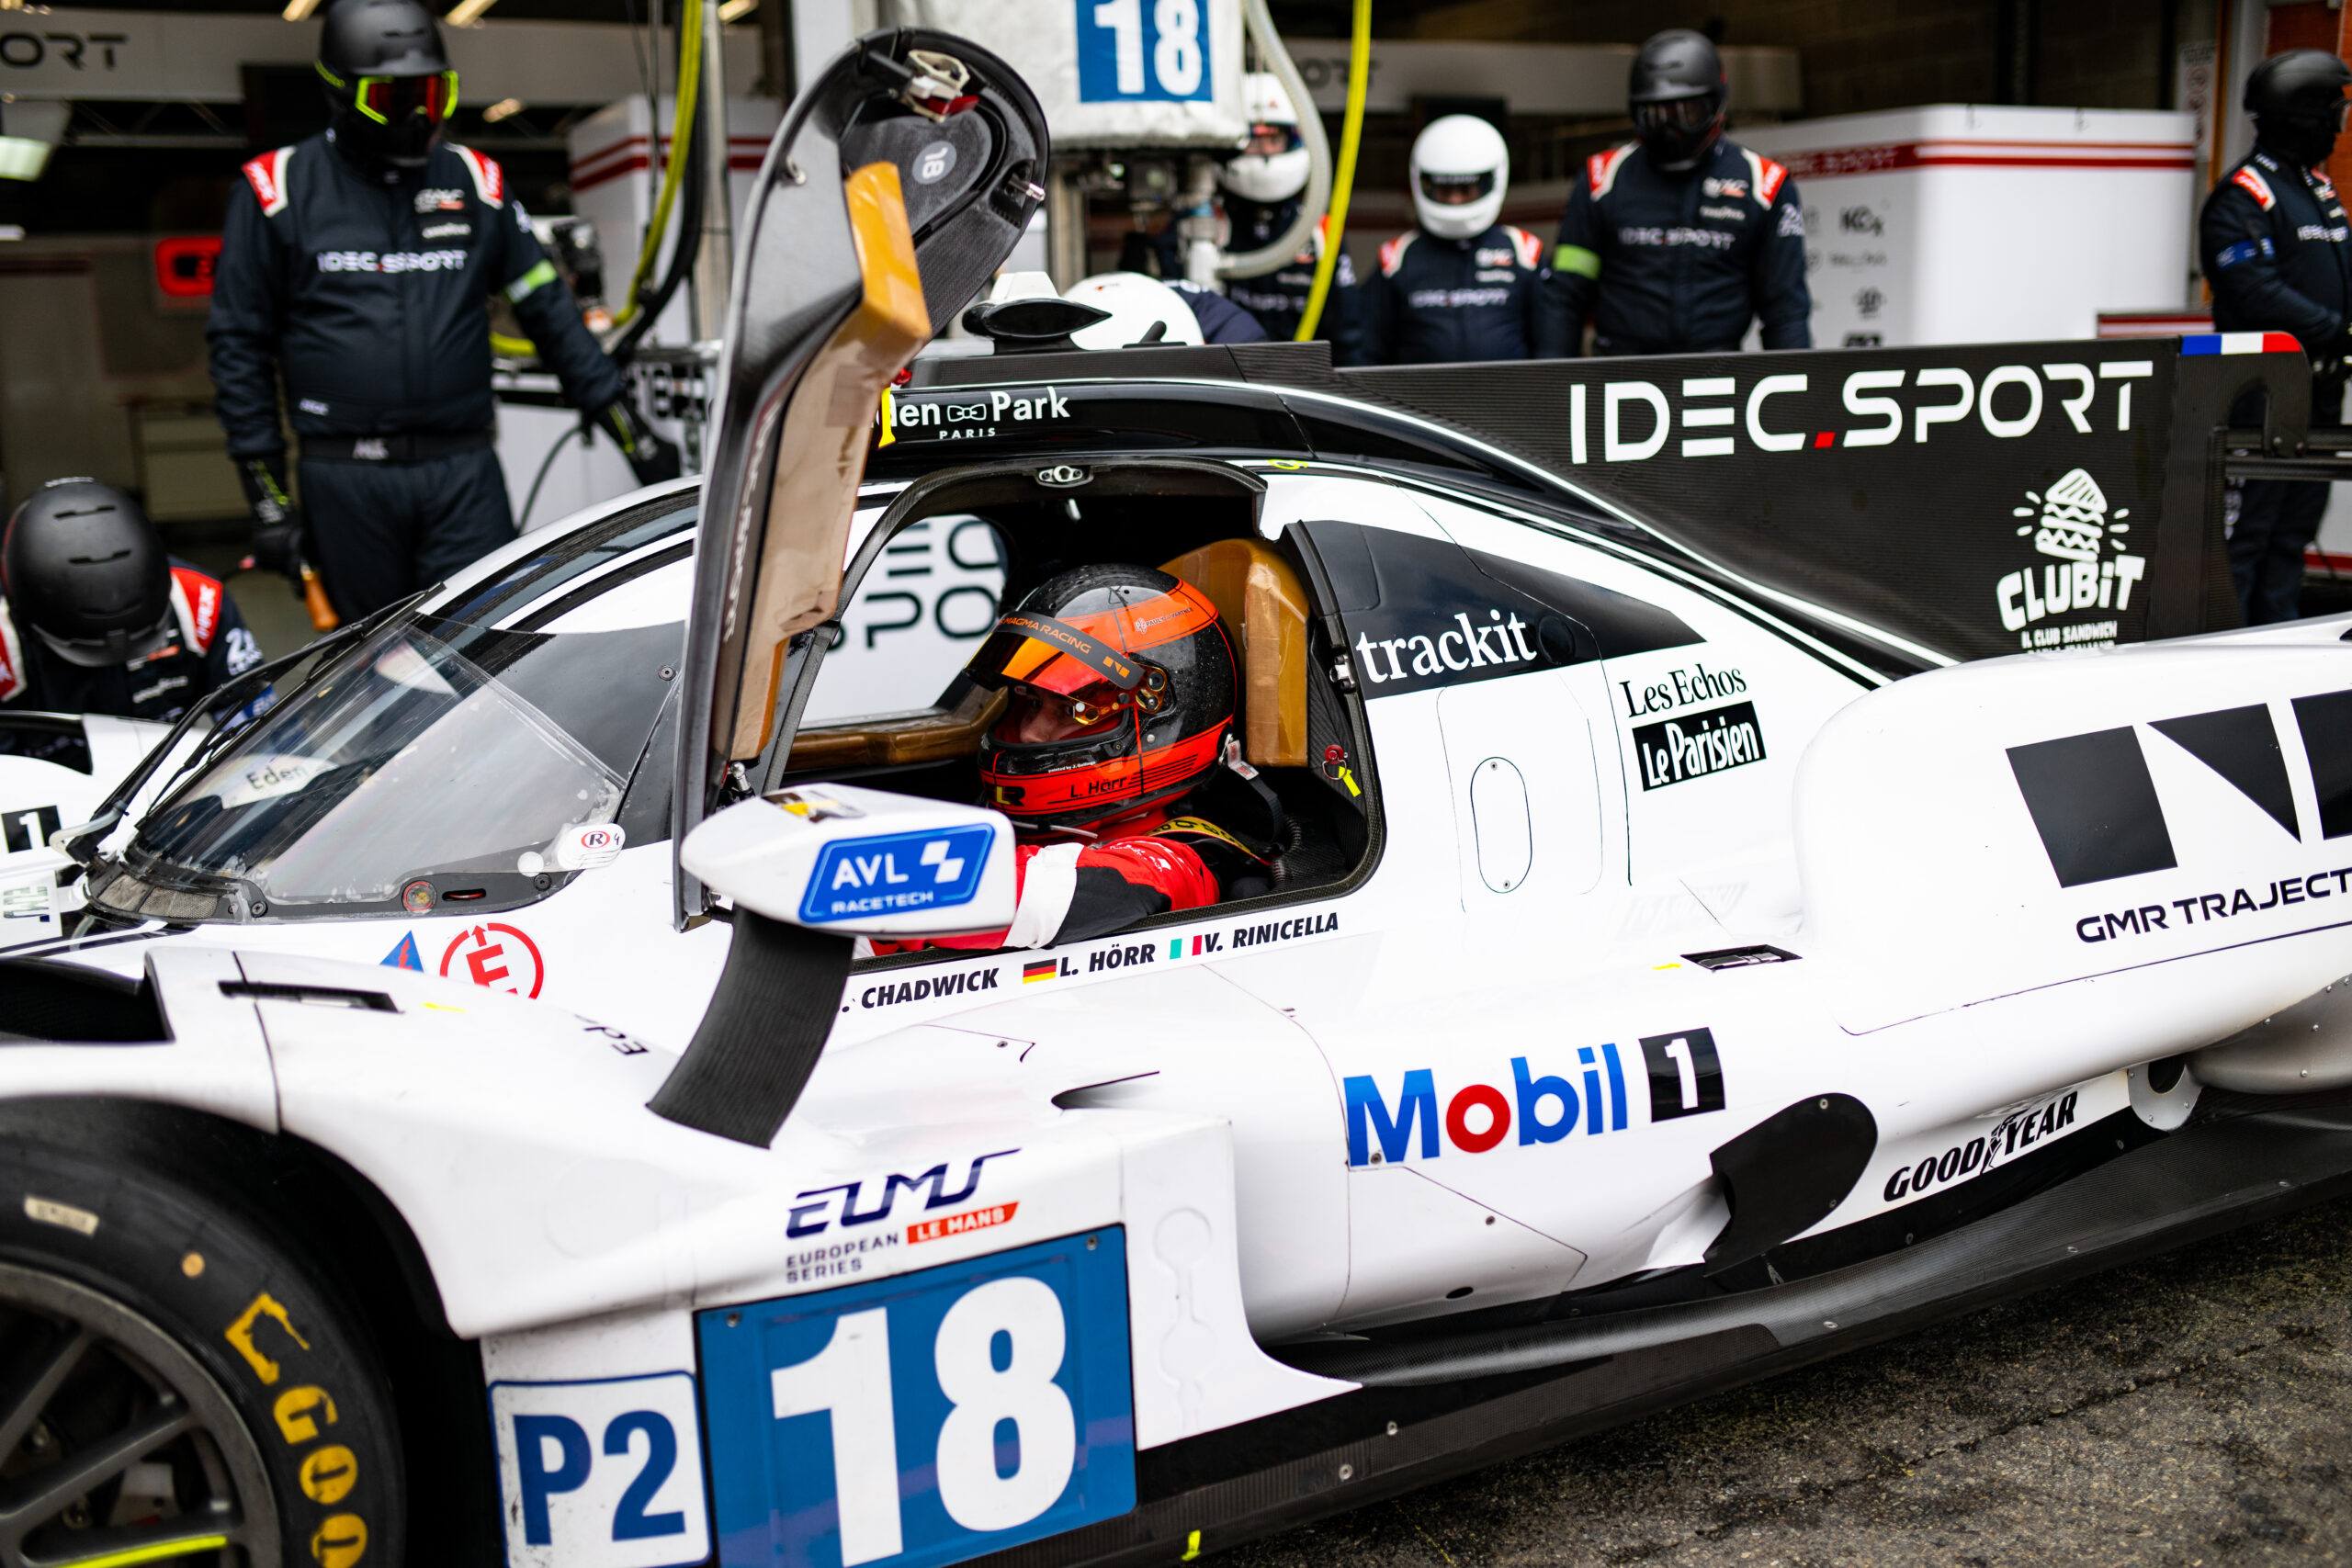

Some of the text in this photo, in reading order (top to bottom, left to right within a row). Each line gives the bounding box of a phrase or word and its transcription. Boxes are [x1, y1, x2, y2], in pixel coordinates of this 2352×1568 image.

[1093, 0, 1204, 96] 18
[922, 147, 948, 179] 18
[990, 386, 1070, 423] Park
[939, 427, 996, 440] PARIS
[1040, 625, 1092, 655] RACING
[1355, 609, 1538, 683] trackit
[2021, 631, 2033, 649] IL
[2033, 627, 2061, 648] CLUB
[2062, 620, 2118, 644] SANDWICH
[1619, 663, 1747, 718] Les Echos
[1642, 715, 1761, 788] Le Parisien
[1070, 776, 1128, 798] L. Hörr
[831, 852, 910, 891] AVL
[831, 890, 934, 915] RACETECH
[2075, 866, 2352, 944] GMR TRAJECT
[1204, 912, 1340, 953] V. RINICELLA
[1059, 942, 1156, 977] L. HÖRR
[861, 967, 1000, 1010] CHADWICK
[1342, 1036, 1700, 1168] Mobil 1
[786, 1206, 1006, 1269] EUROPEAN LE MANS
[786, 1258, 863, 1284] SERIES
[770, 1275, 1077, 1567] 18
[512, 1409, 686, 1547] P2
